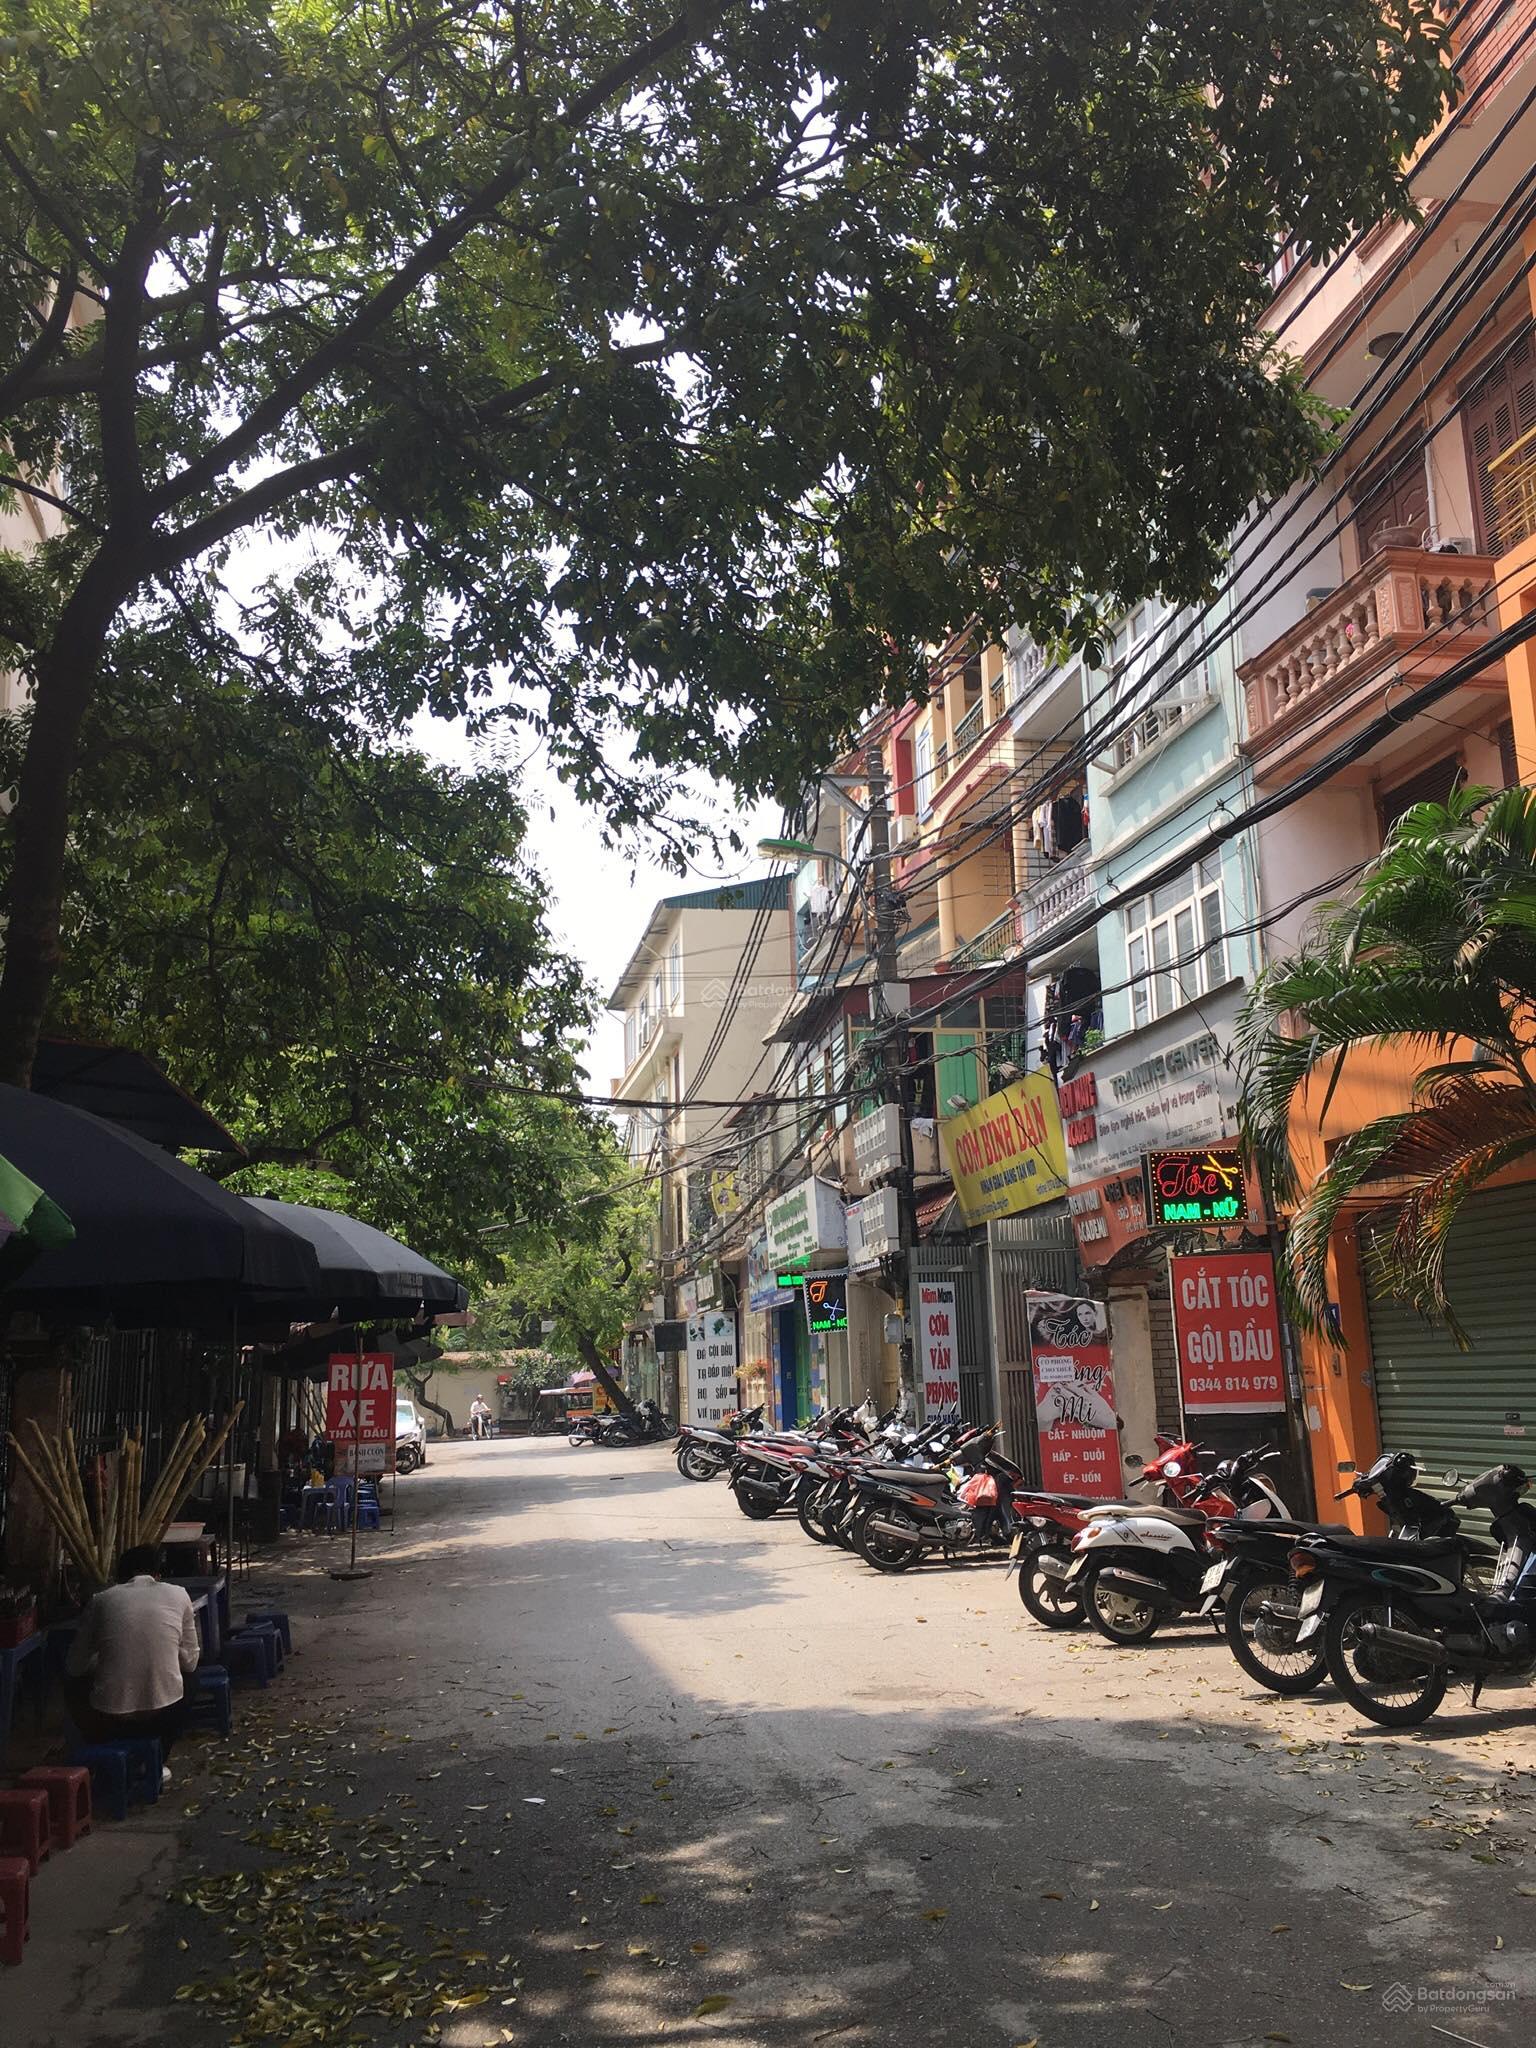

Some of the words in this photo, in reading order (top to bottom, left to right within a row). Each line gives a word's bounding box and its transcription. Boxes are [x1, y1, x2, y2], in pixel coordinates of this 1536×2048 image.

[1156, 1156, 1219, 1198] Tóc
[1163, 1202, 1201, 1221] NAM
[1213, 1196, 1239, 1218] NỮ
[1182, 1267, 1222, 1311] CẮT
[1227, 1268, 1269, 1308] TÓC
[812, 1320, 831, 1330] NAM
[929, 1310, 950, 1337] CƠM
[929, 1341, 951, 1371] VĂN
[1187, 1323, 1224, 1371] GỘI
[1228, 1317, 1274, 1363] ĐẦU
[1189, 1377, 1222, 1392] 0344
[1225, 1376, 1250, 1391] 814
[1252, 1375, 1278, 1390] 979
[338, 1399, 376, 1428] XE
